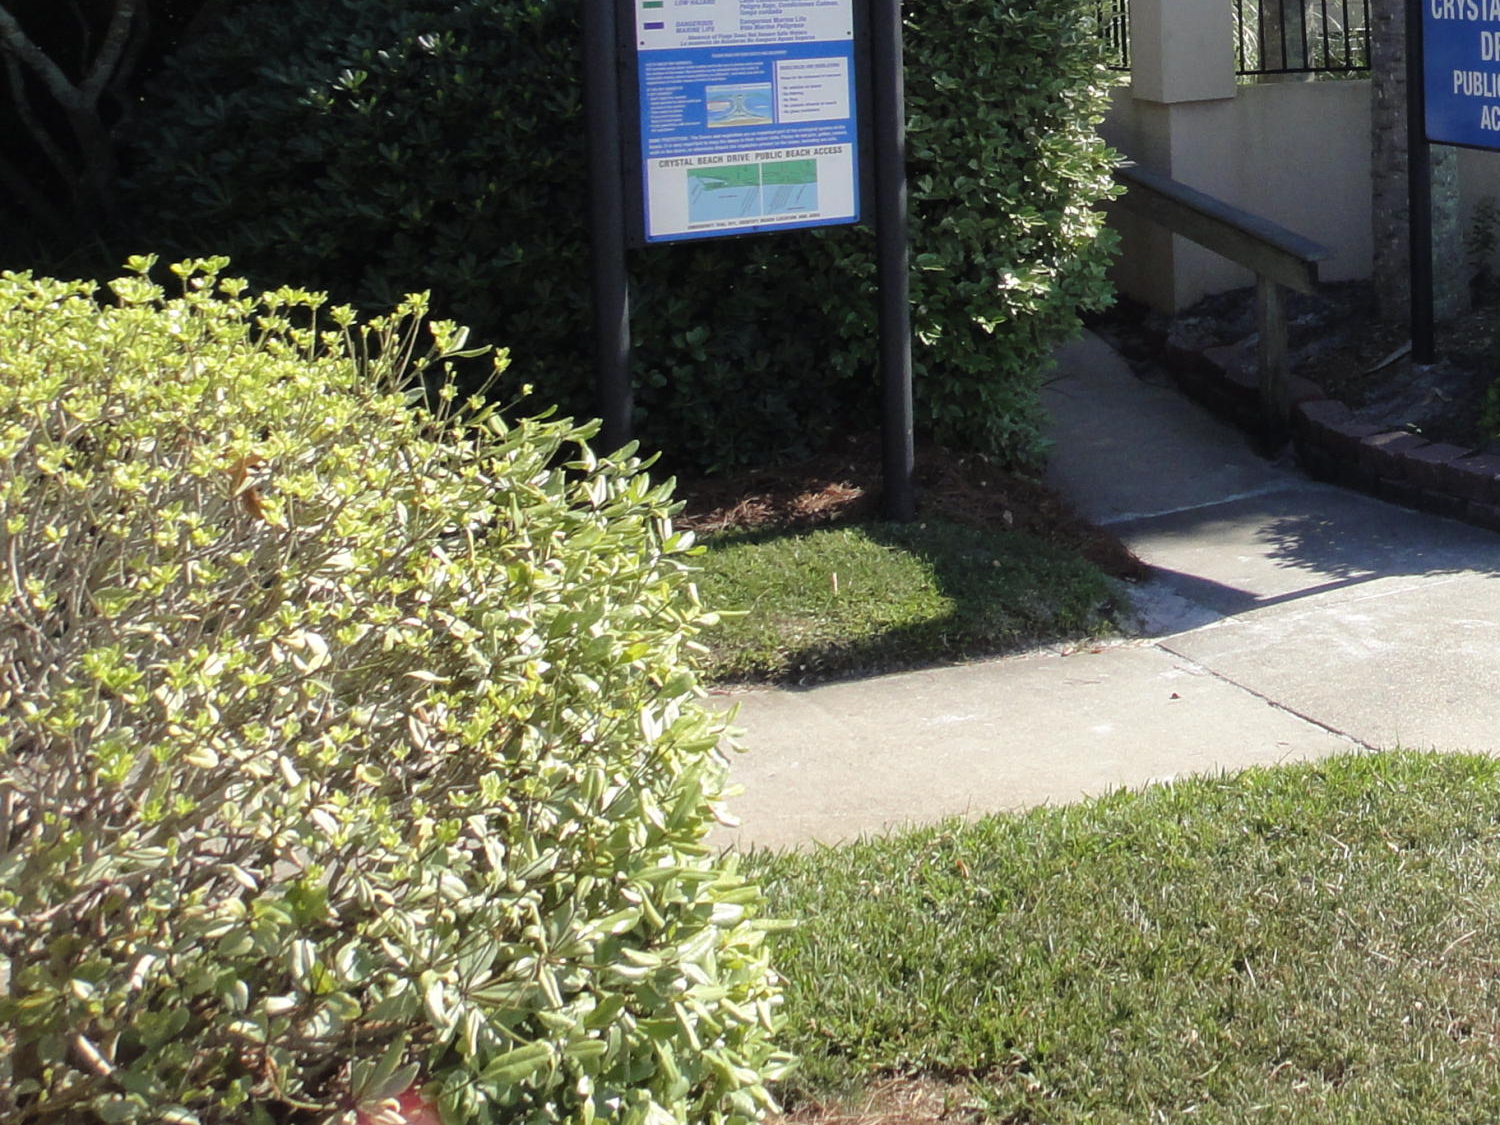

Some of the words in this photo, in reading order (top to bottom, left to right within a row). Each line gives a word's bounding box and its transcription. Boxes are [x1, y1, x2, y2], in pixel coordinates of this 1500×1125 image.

[658, 157, 694, 168] CRYSTAL
[697, 155, 724, 165] BEACH
[726, 153, 750, 163] DRIVE
[754, 150, 783, 161] PUBLIC
[785, 148, 811, 159] BEACH
[813, 145, 843, 156] ACCESS
